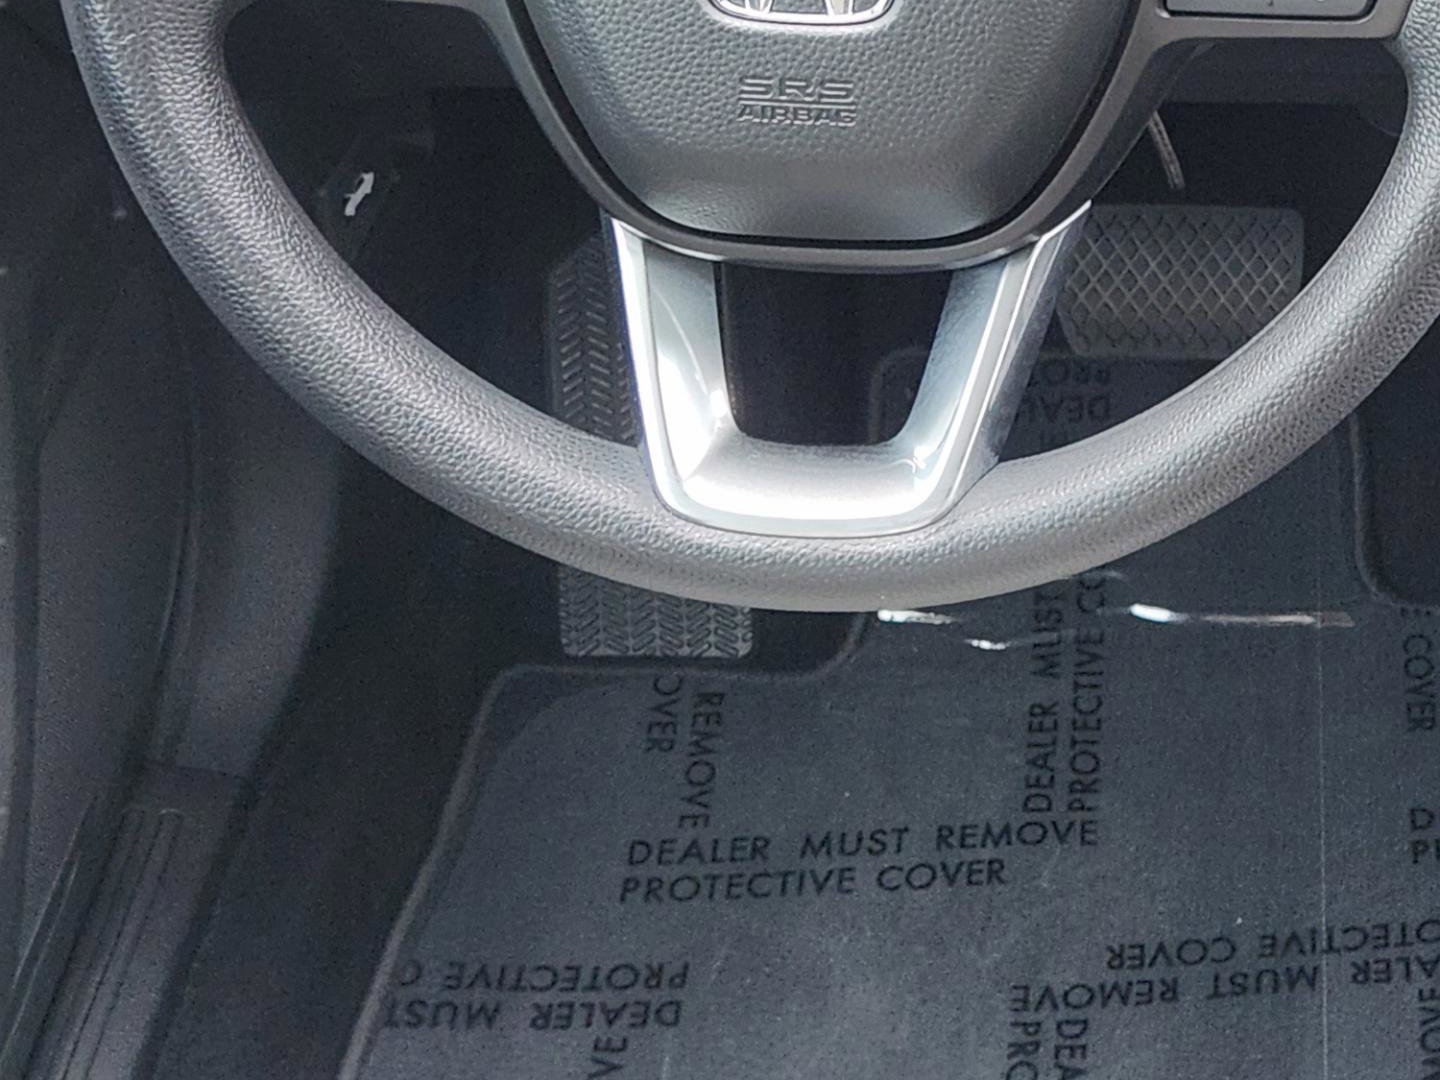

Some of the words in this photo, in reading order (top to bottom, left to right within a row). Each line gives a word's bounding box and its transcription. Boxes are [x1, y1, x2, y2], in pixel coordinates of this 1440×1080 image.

[739, 76, 854, 103] SRS
[1402, 633, 1437, 732] COVER
[1066, 627, 1106, 813] PROTECTIVE
[678, 691, 725, 829] REMOVE
[1021, 700, 1060, 813] DEALER
[626, 835, 771, 867] DEALER
[800, 825, 910, 861] MUST
[934, 819, 1100, 852] REMOVE
[618, 865, 856, 905] PROTECTIVE
[875, 857, 1009, 892] COVER
[1104, 935, 1239, 972] COVER
[443, 960, 690, 993] PROTECTIVE
[1008, 975, 1180, 1014] REMOVE
[1205, 963, 1321, 1001] MUST
[529, 999, 684, 1031] DEALER
